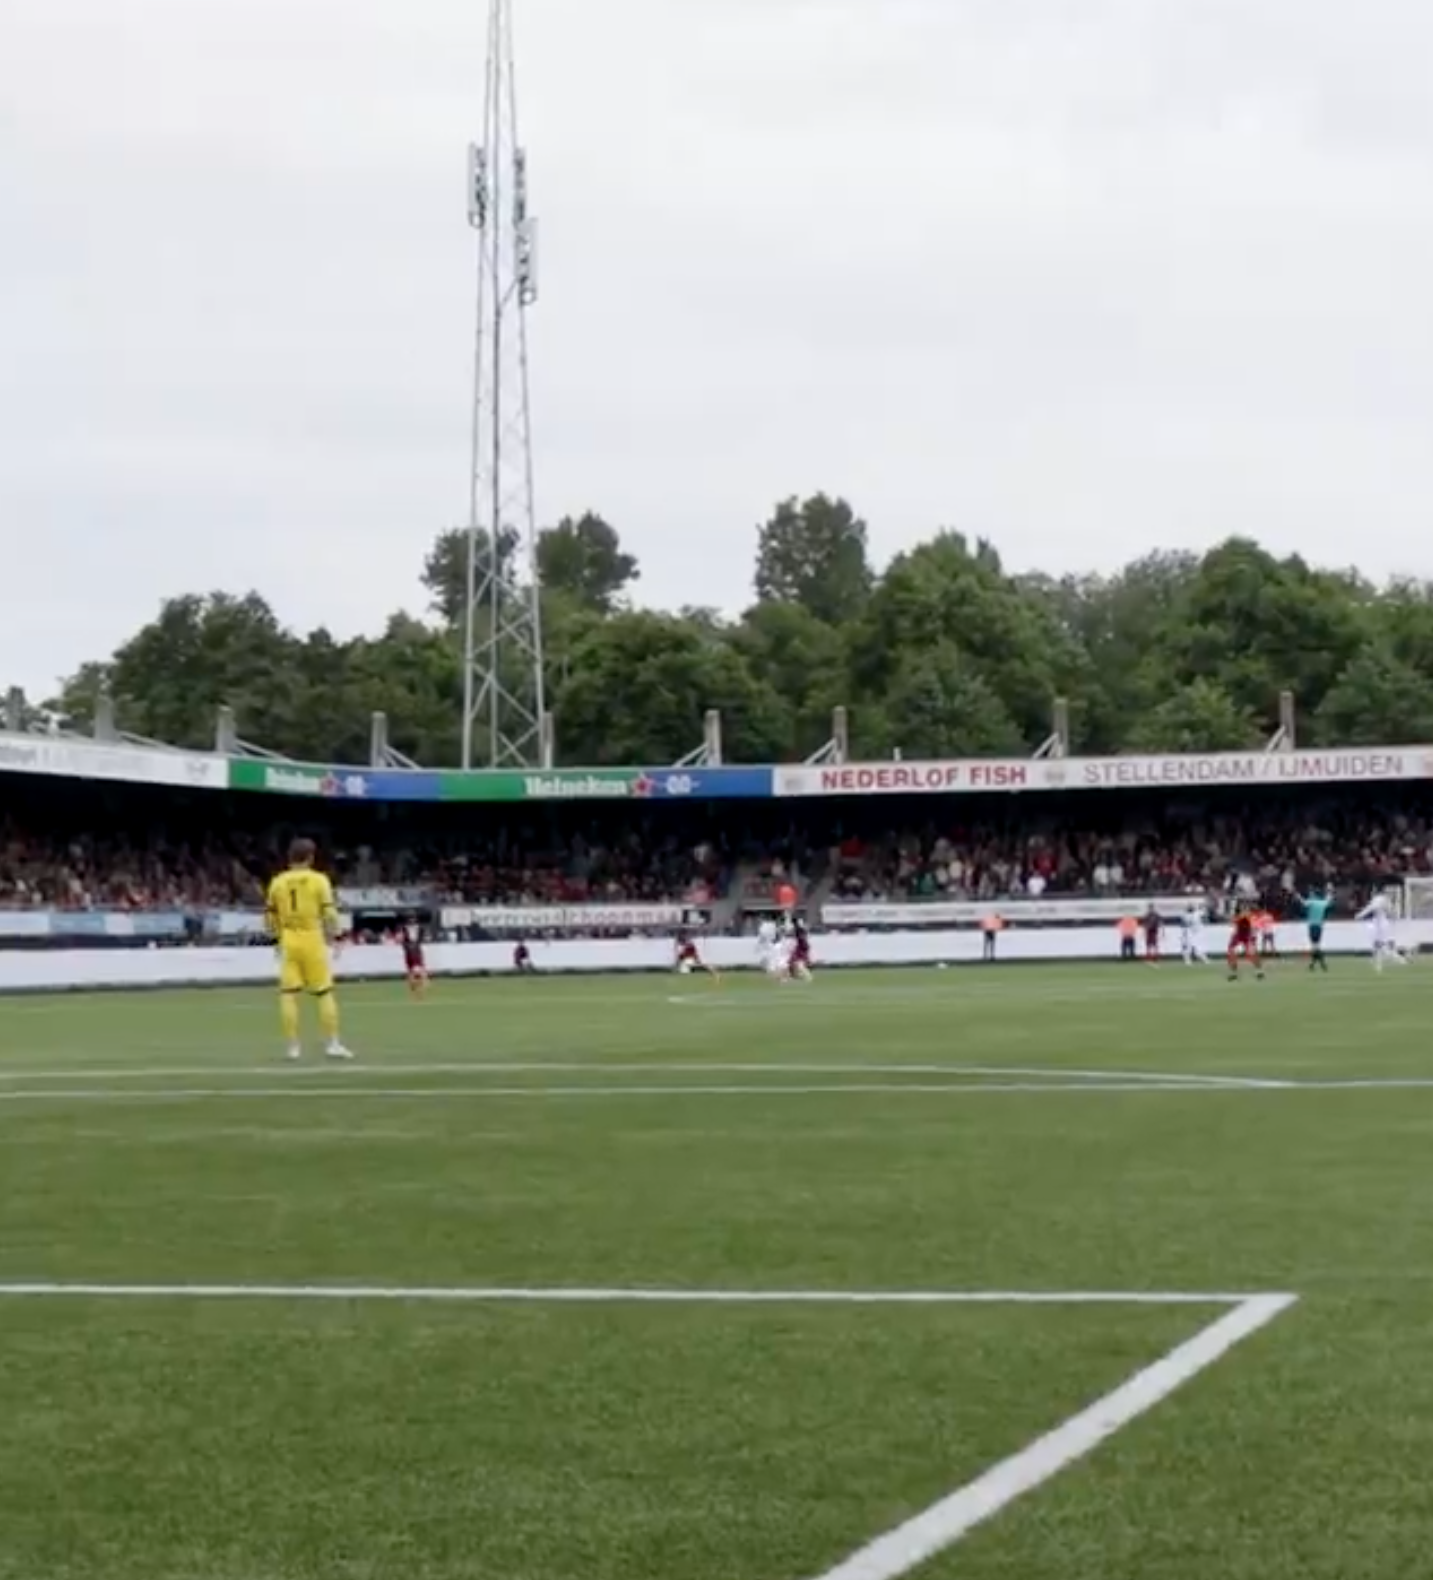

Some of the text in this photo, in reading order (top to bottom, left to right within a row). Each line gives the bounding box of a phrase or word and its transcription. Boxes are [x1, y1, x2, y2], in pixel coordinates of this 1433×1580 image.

[822, 766, 1026, 790] NEDERLOF FISH
[1084, 758, 1254, 783] STELLENDAM
[1279, 755, 1402, 777] IJMUIDEN
[290, 888, 298, 912] 1
